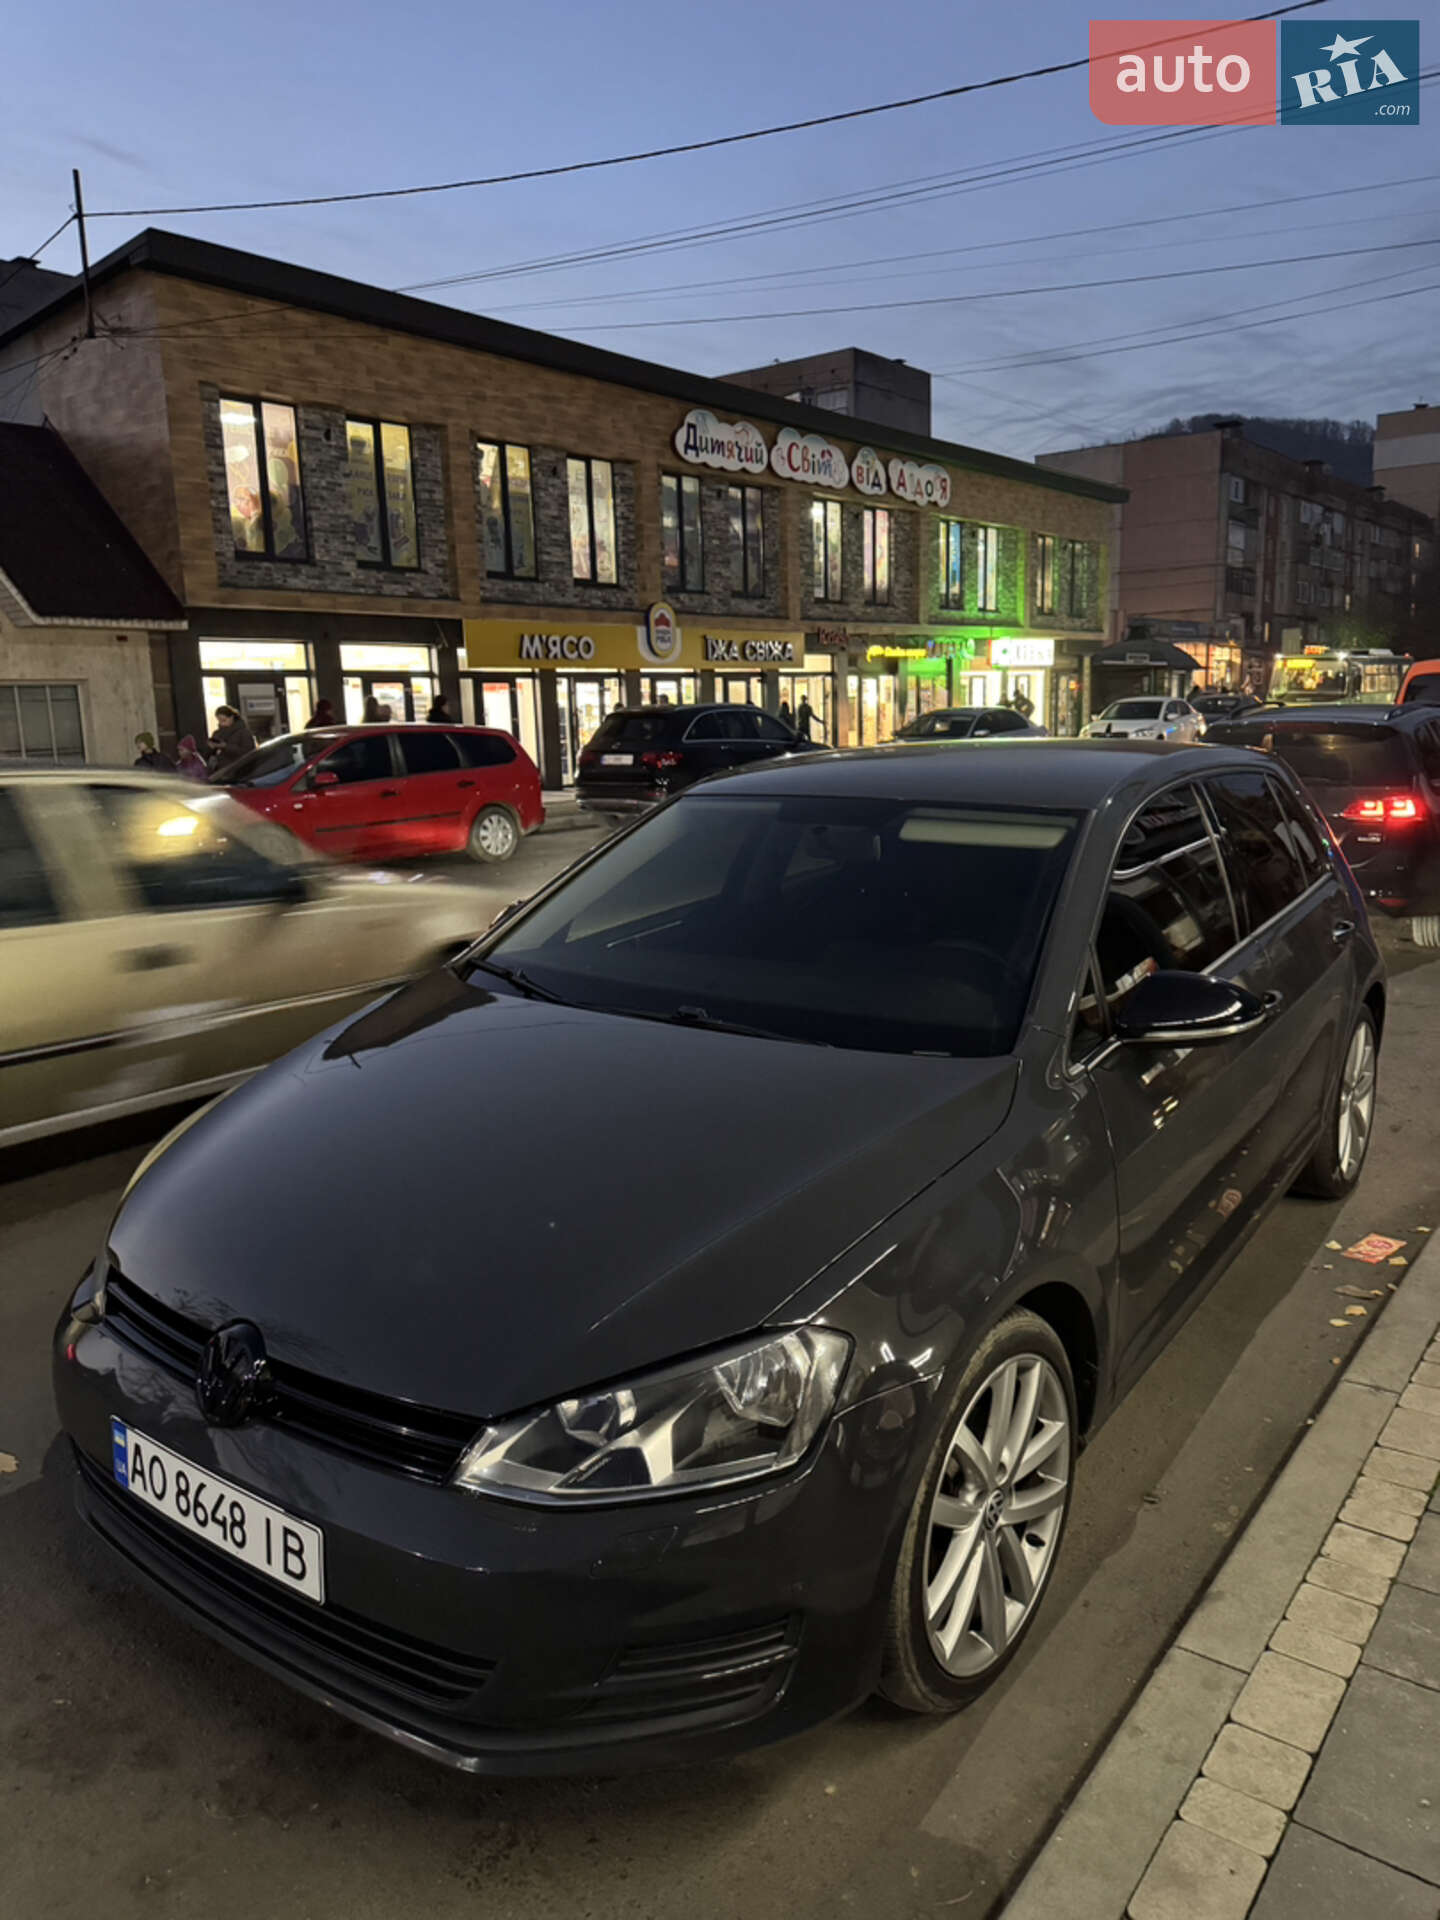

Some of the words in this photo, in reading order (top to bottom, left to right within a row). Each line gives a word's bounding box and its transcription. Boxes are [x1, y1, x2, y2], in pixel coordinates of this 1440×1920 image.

[683, 422, 764, 466] Дитячий
[787, 442, 833, 477] Світ
[520, 635, 595, 660] М'ЯСО
[744, 639, 793, 662] СВІЖА
[130, 1442, 168, 1502] AO
[175, 1469, 247, 1550] 8648
[265, 1517, 307, 1582] IB
